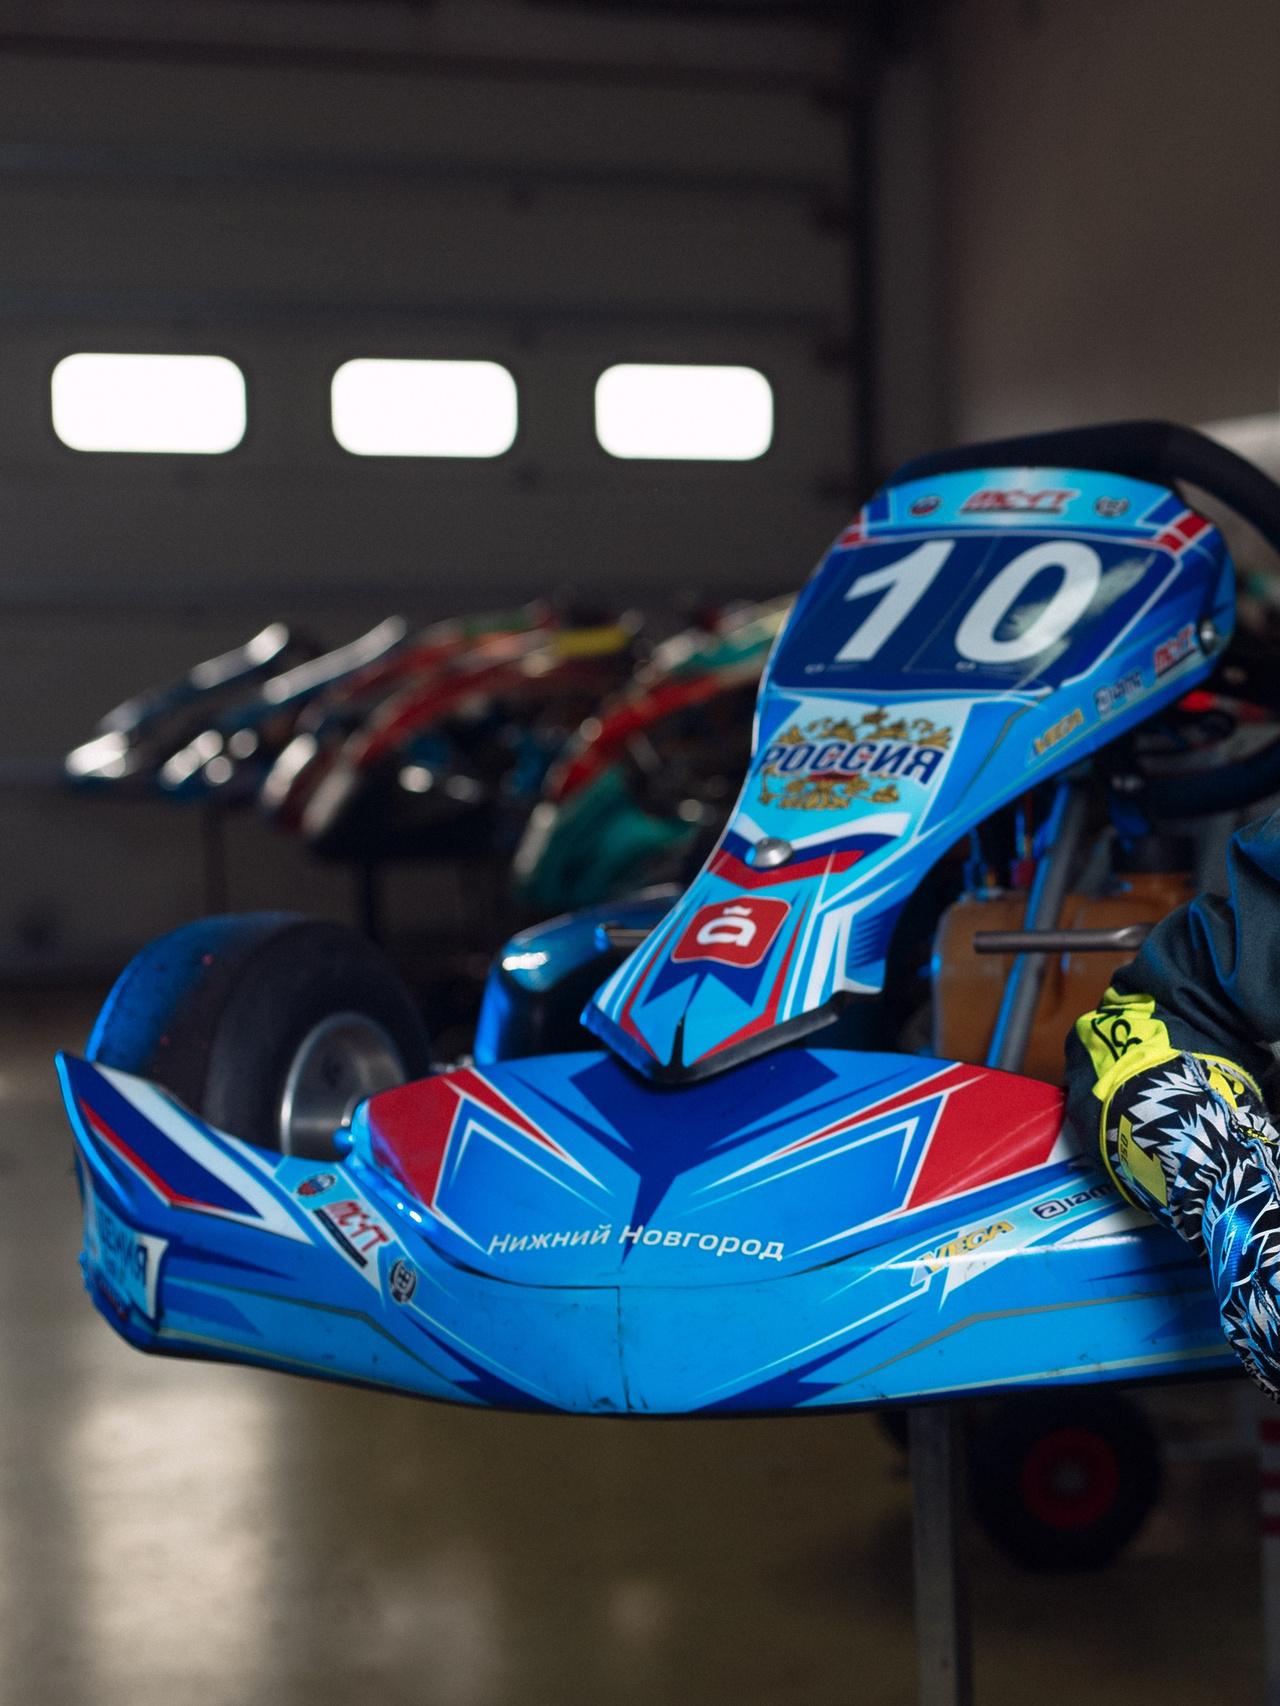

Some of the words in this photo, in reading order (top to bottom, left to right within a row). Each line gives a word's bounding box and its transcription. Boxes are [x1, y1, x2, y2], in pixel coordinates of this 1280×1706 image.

[834, 538, 1102, 665] 10
[758, 740, 950, 785] РОССИЯ
[487, 1223, 612, 1256] Нижний
[618, 1224, 785, 1262] Новгород
[921, 1221, 1015, 1274] VEGA
